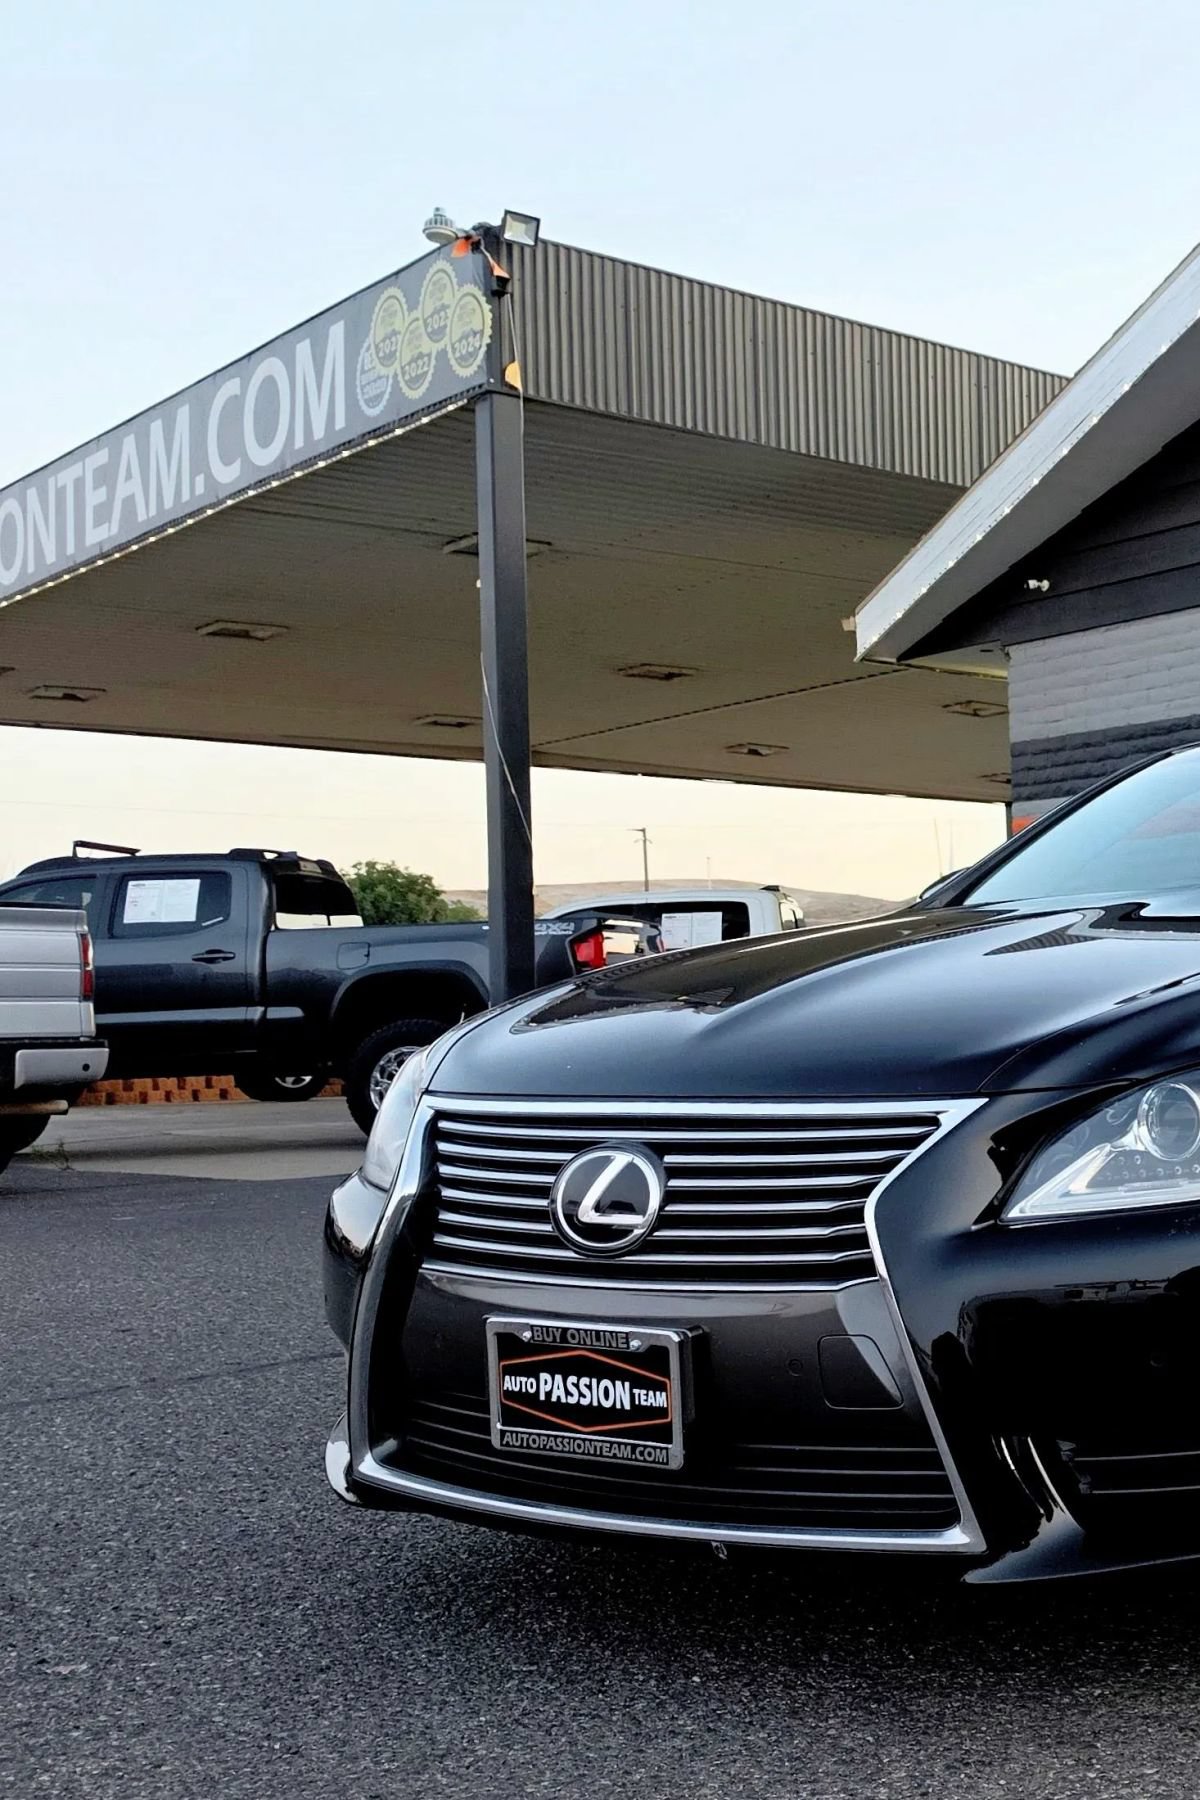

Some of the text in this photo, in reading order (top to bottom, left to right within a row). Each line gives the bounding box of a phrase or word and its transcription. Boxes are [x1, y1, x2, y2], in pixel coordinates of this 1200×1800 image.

[454, 333, 481, 358] 2024
[402, 356, 429, 381] 2022
[533, 1327, 628, 1348] BUY ONLINE
[503, 1373, 667, 1410] AUTO PASSION TEAM
[503, 1432, 668, 1462] AUTOPASSIONTEAM.COM
